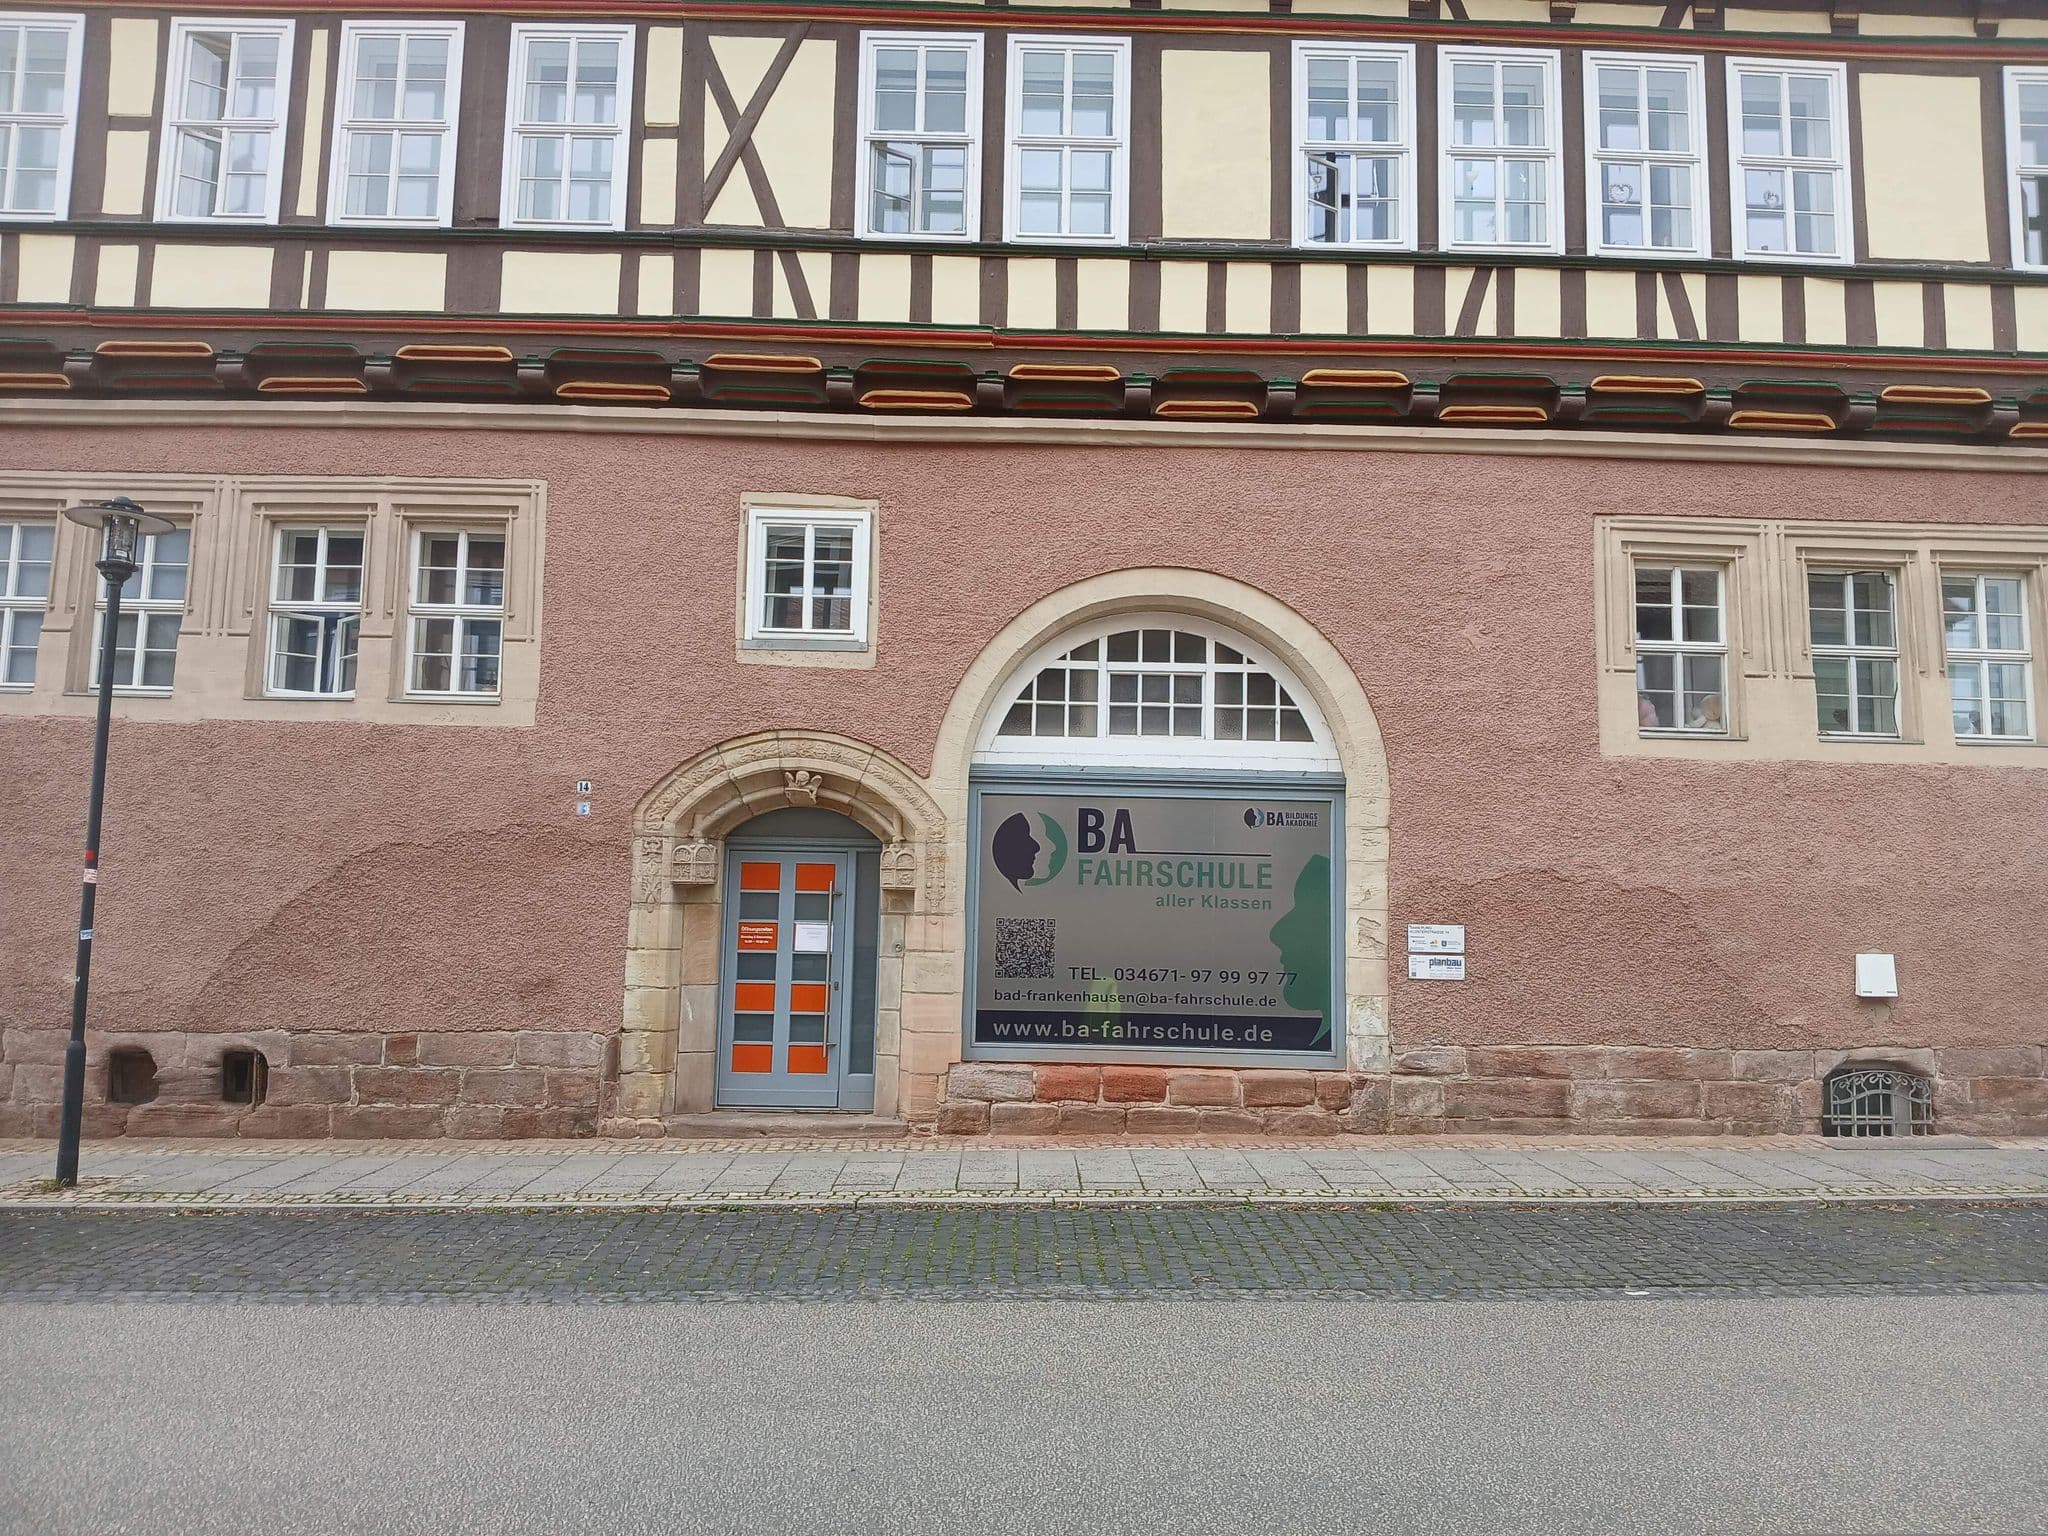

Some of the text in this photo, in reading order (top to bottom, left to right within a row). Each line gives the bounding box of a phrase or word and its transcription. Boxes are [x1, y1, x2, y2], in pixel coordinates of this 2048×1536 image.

[579, 782, 590, 791] 14
[1266, 812, 1318, 826] BA BILDUNGS
[1077, 807, 1136, 854] BA
[1077, 859, 1273, 889] FAHRSCHULE
[1156, 893, 1272, 910] aller Klassen
[1429, 957, 1462, 969] planbau
[1068, 967, 1298, 986] TEL. 034671- 97 99 97 77
[994, 988, 1277, 1008] bad-frankenhausen@ba-fahrschule.de
[993, 1020, 1273, 1042] www.ba-fahrschule.de
